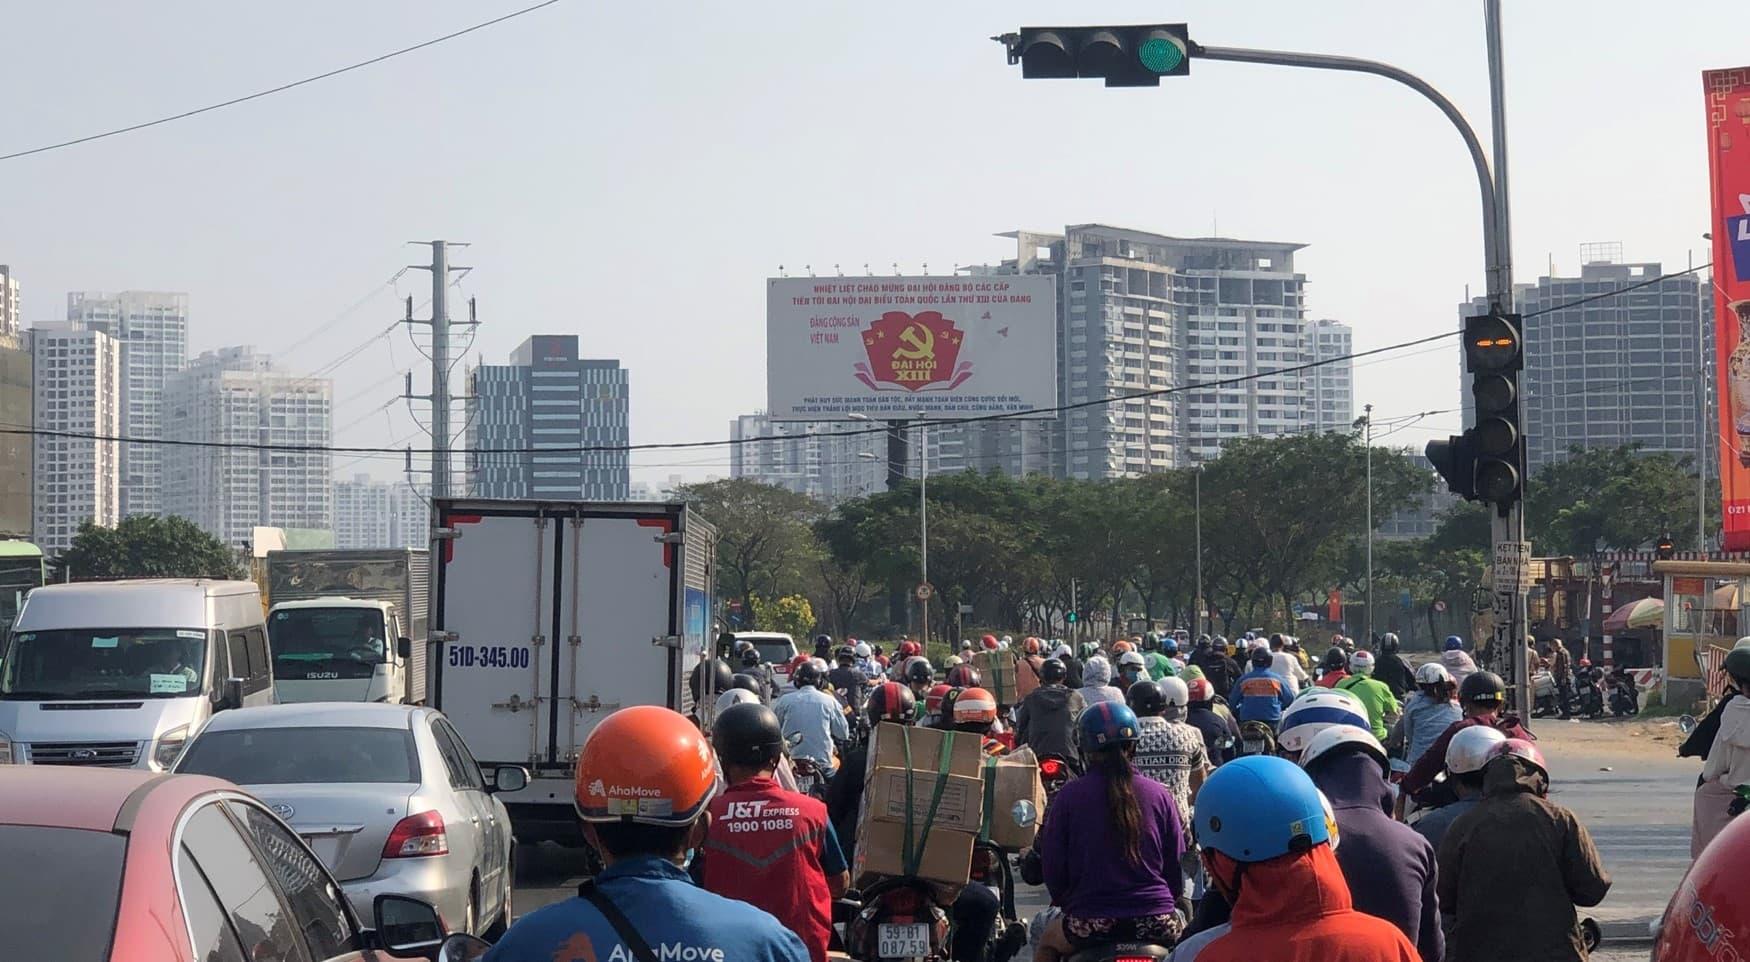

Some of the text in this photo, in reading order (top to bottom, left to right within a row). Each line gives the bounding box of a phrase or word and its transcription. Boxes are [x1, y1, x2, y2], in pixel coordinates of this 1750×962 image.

[814, 284, 836, 293] NHIỆT
[839, 284, 855, 293] LIỆT
[857, 284, 879, 293] CHÀO
[907, 283, 920, 292] ĐẠI
[923, 283, 936, 292] HỘI
[939, 283, 960, 292] ĐẢNG
[976, 282, 991, 291] CÁC
[994, 282, 1009, 291] CẤP
[812, 296, 824, 305] TỚI
[827, 296, 839, 305] ĐẠI
[842, 296, 855, 304] HỘI
[859, 295, 871, 304] ĐẠI
[874, 295, 892, 304] BIỂU
[895, 295, 914, 304] TOÀN
[917, 295, 938, 304] QUỐC
[992, 294, 1007, 303] CỦA
[1010, 294, 1031, 303] ĐẢNG
[810, 314, 860, 329] ĐẢNG CỘNG SẢN
[810, 331, 839, 344] VIỆT NAM
[894, 371, 931, 380] XIII
[450, 646, 529, 668] 51D-345.00
[1168, 756, 1189, 765] DIOR
[608, 785, 661, 797] AhaMove
[720, 800, 800, 820] J&T EXPRESS
[727, 819, 794, 833] 1900 1088
[608, 942, 725, 962] AMove
[882, 940, 925, 955] 087.59
